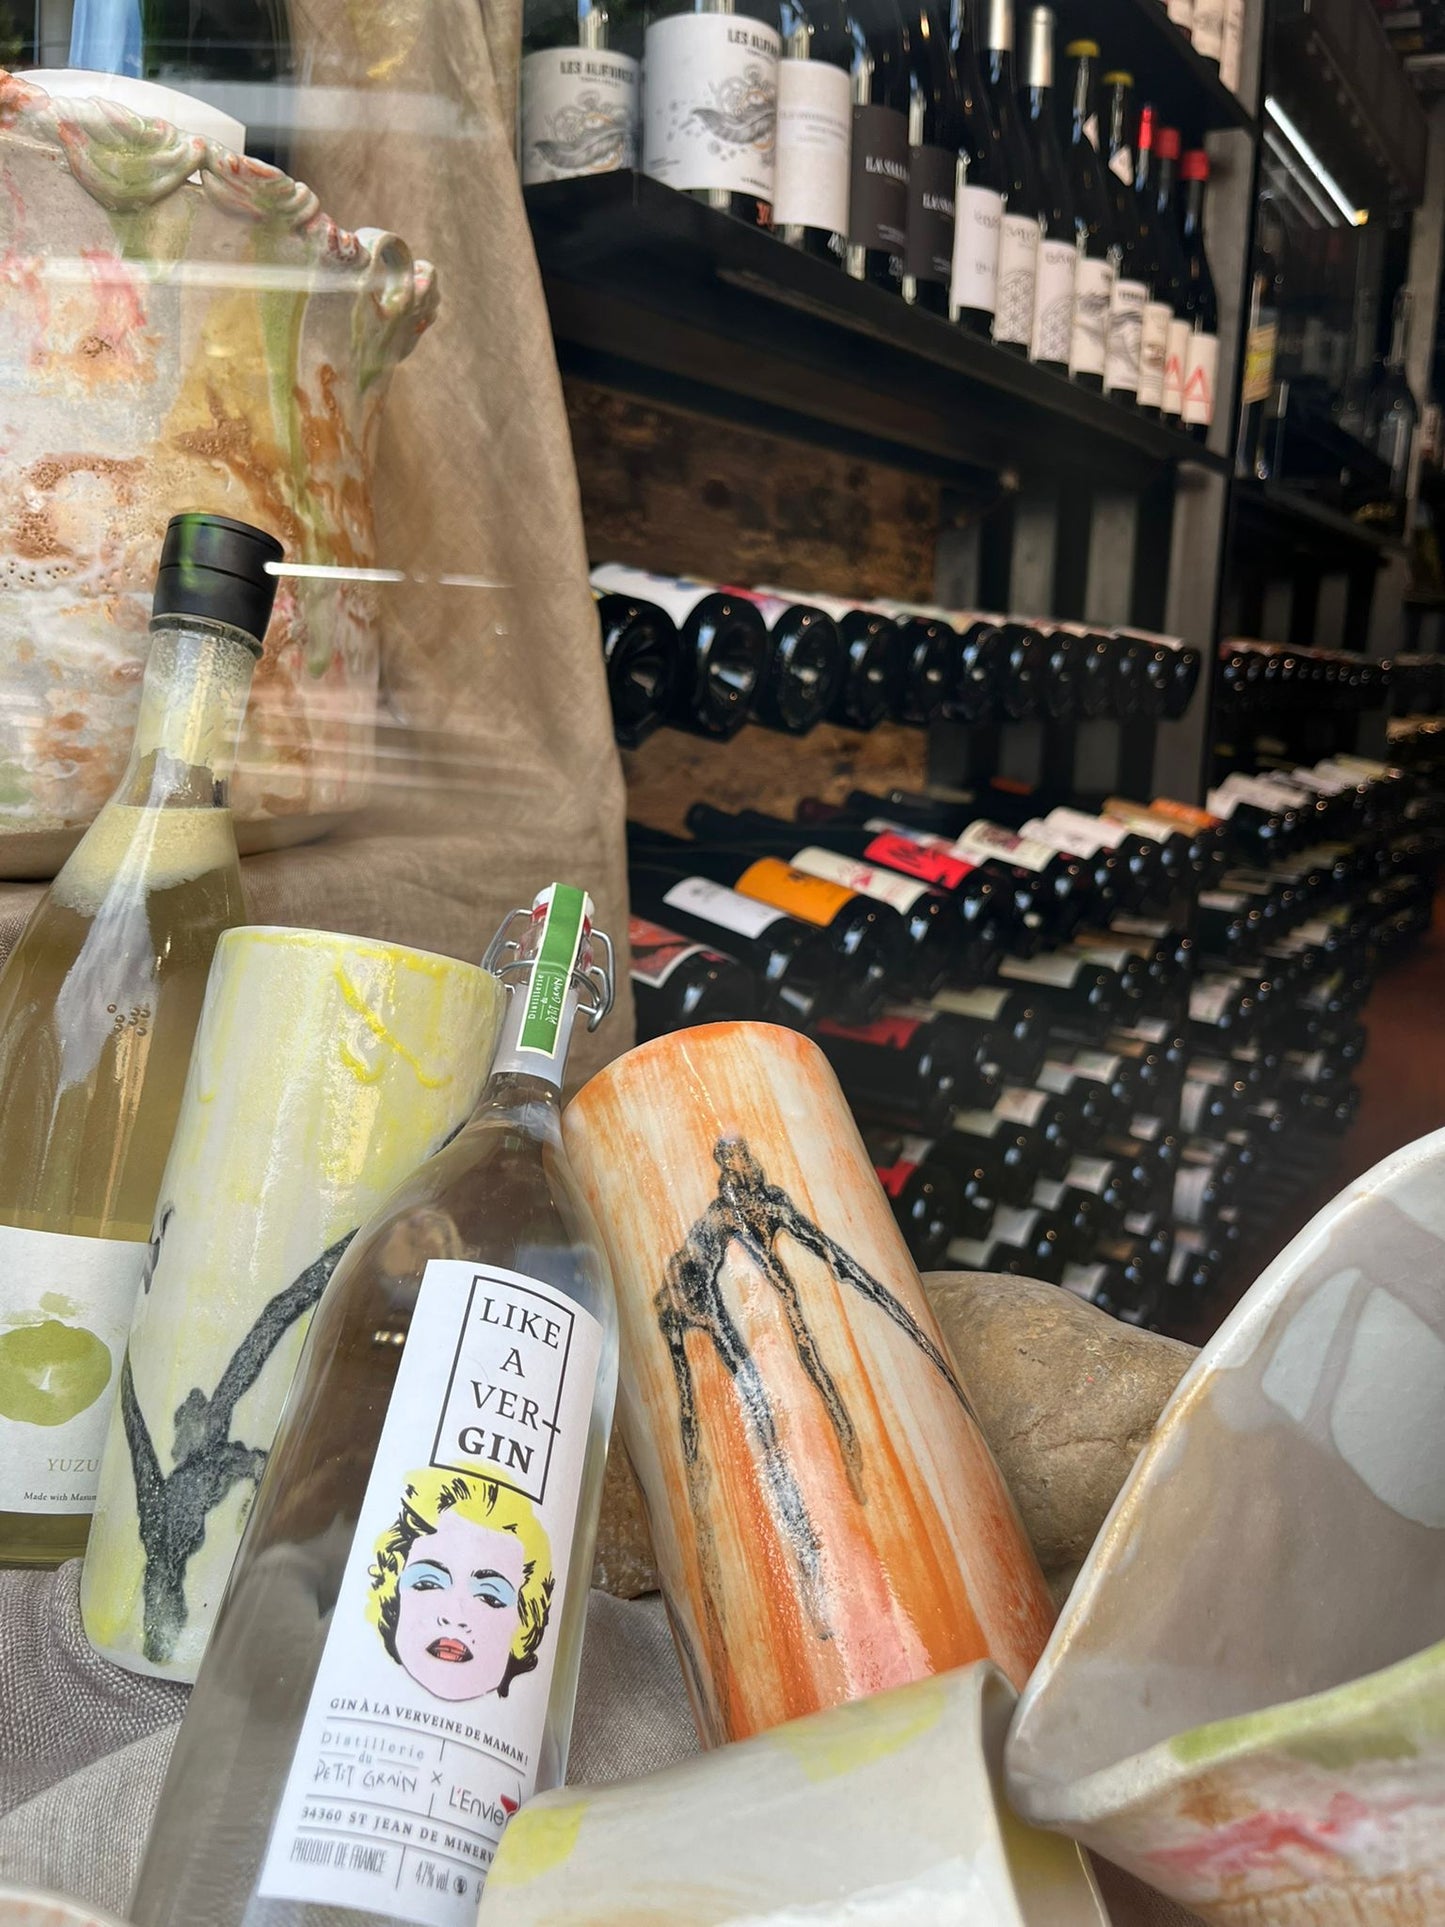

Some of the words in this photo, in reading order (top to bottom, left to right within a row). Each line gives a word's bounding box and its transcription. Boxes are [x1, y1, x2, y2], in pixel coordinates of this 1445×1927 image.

[480, 1297, 561, 1349] LIKE
[499, 1347, 525, 1378] A
[48, 1458, 100, 1473] YUZU
[458, 1426, 535, 1475] GIN
[23, 1491, 47, 1501] Made
[50, 1492, 68, 1501] with
[330, 1697, 357, 1711] GIN
[359, 1696, 370, 1712] À
[373, 1702, 390, 1716] LA
[396, 1706, 463, 1734] VERVEINE
[464, 1725, 481, 1741] DE
[321, 1731, 425, 1761] Distillerie
[358, 1750, 373, 1764] du
[301, 1806, 343, 1821] 34360
[349, 1811, 367, 1825] ST
[373, 1816, 414, 1836] JEAN
[420, 1827, 439, 1843] DE
[290, 1837, 335, 1865] PRODUIT
[334, 1842, 351, 1868] DE
[349, 1844, 387, 1873] FRANCE
[415, 1860, 436, 1889] 47%
